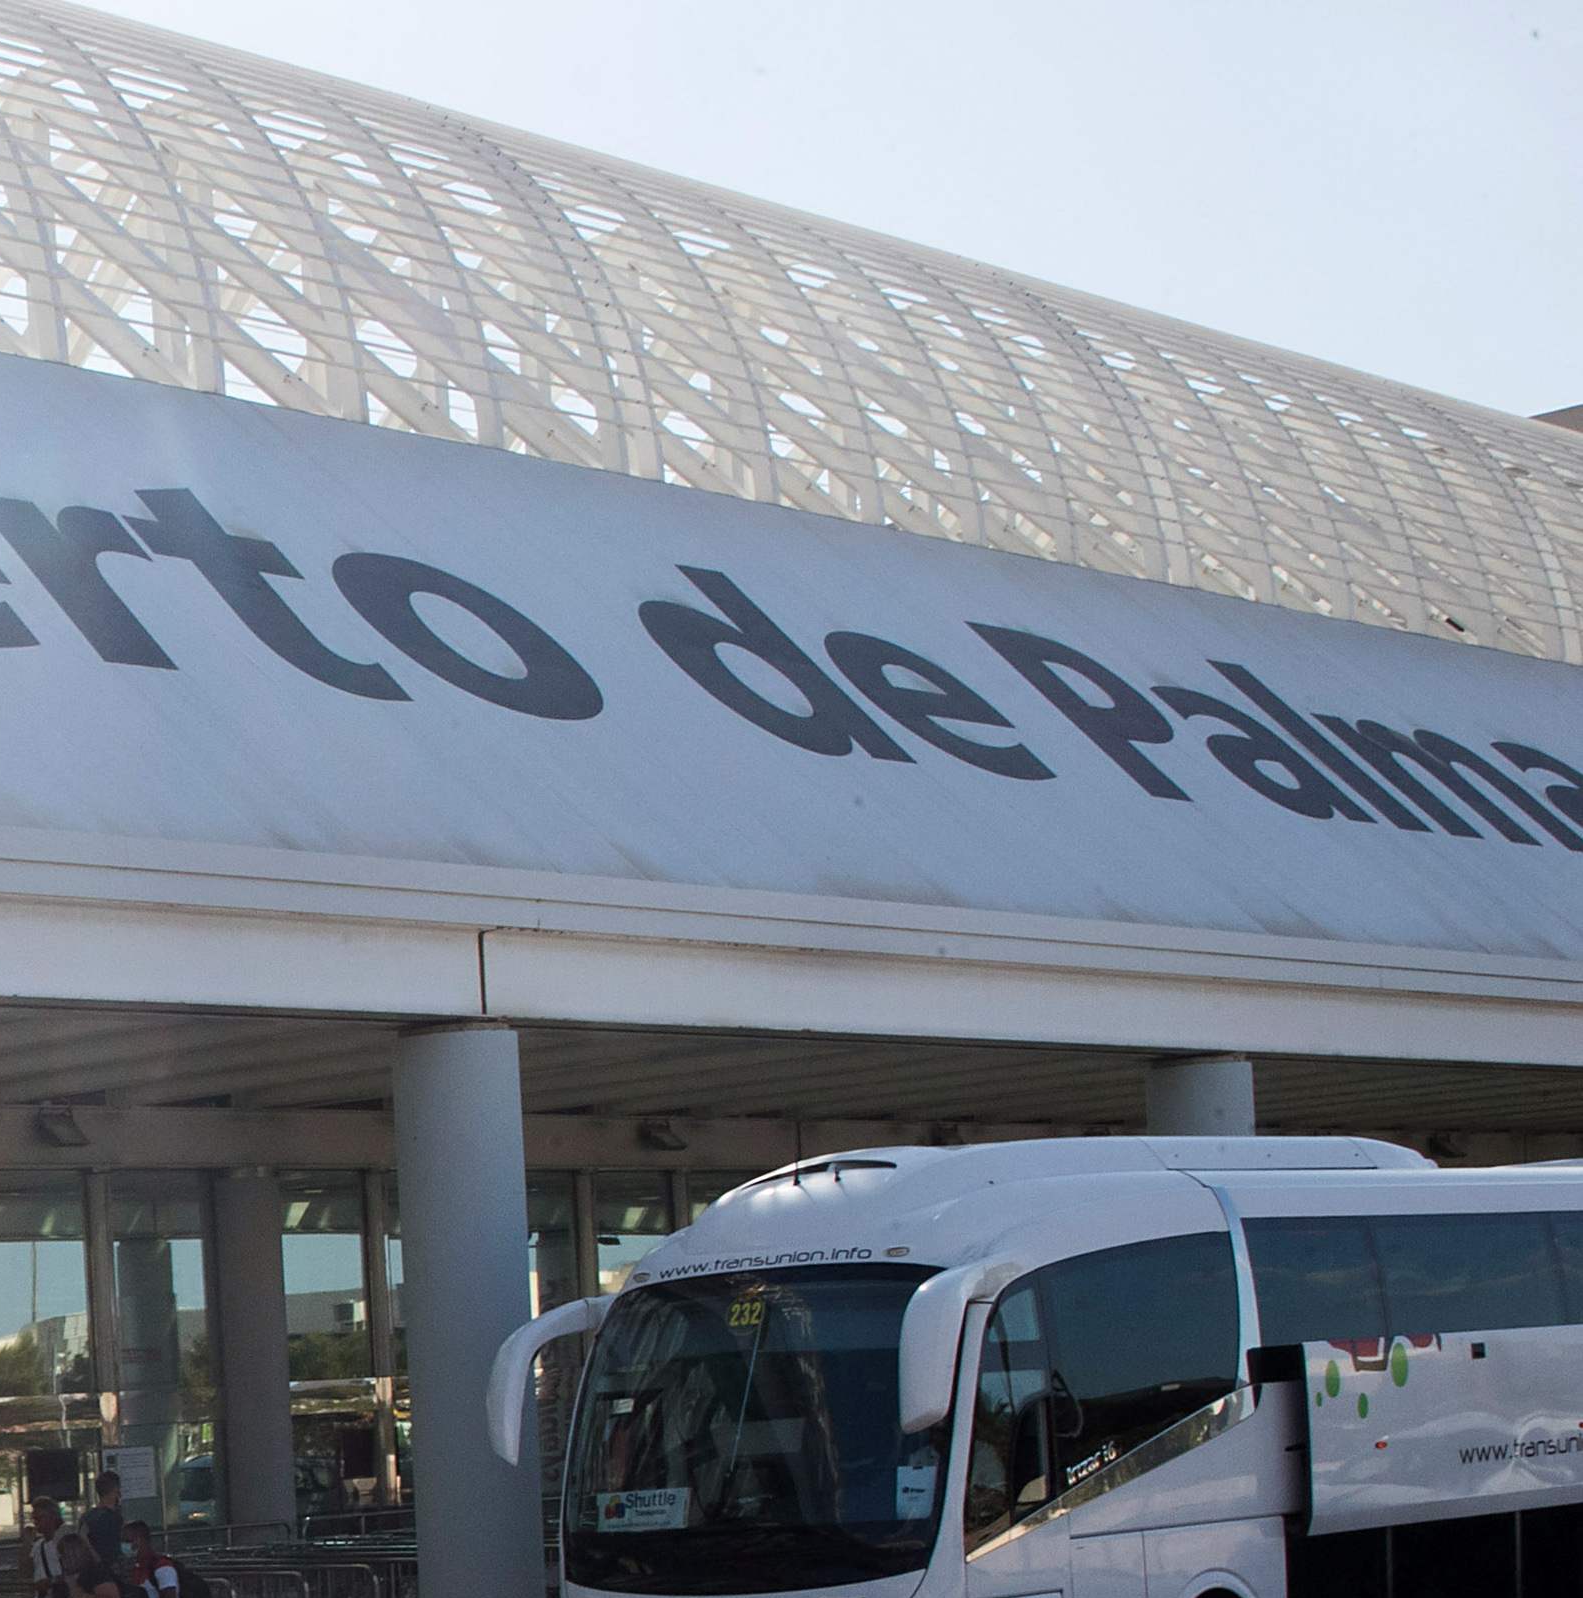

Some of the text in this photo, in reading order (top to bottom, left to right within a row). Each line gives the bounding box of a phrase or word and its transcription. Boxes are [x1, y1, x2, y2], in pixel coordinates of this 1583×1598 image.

[637, 564, 1053, 781] de
[659, 1247, 872, 1279] www.transunion.info
[729, 1302, 761, 1327] 232
[625, 1492, 676, 1509] Shuttle
